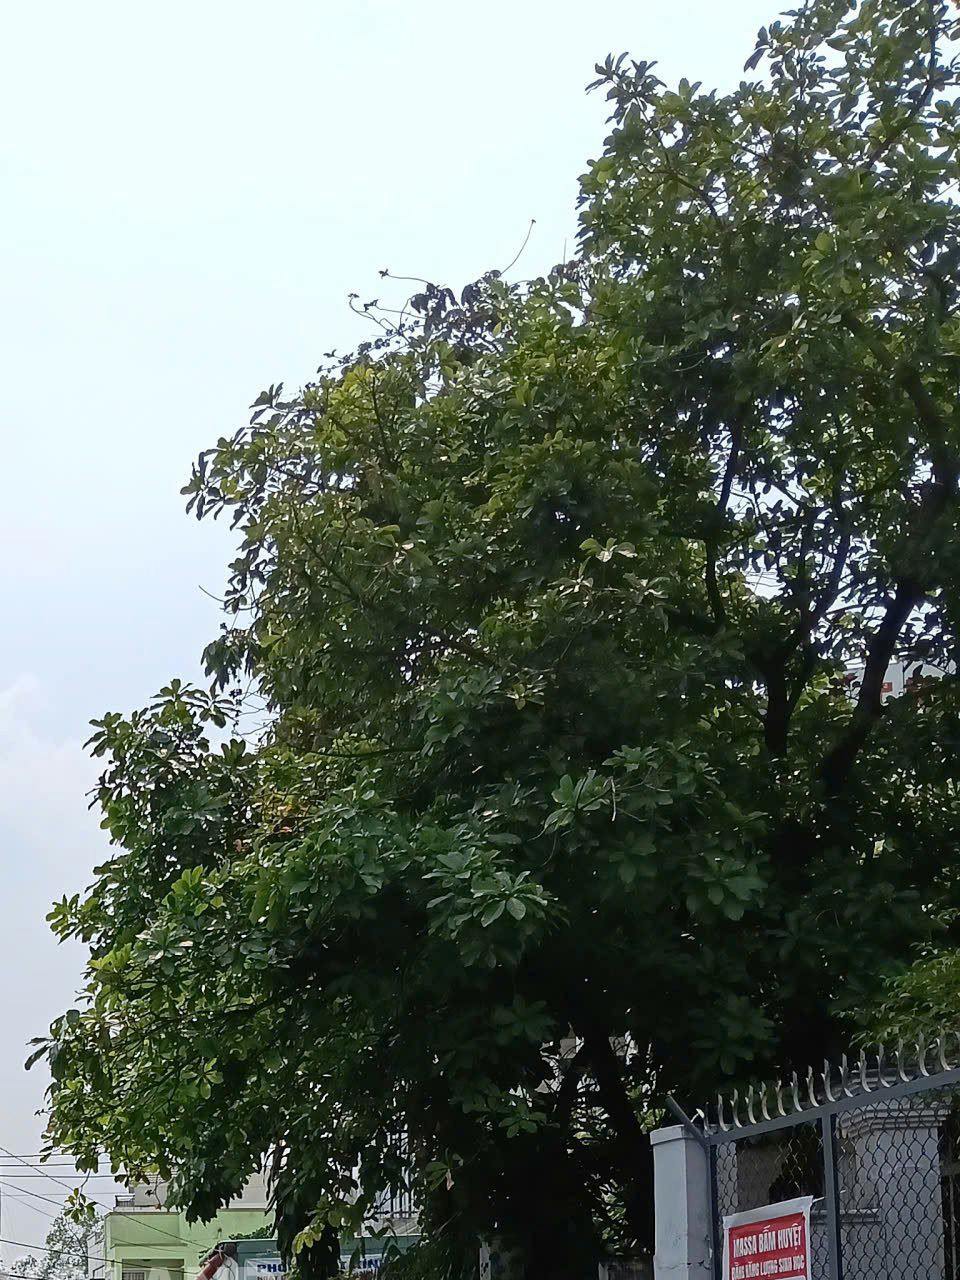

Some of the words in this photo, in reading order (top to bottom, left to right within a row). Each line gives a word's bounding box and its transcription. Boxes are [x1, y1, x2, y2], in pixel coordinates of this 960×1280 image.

[734, 1235, 757, 1258] MASSA
[759, 1225, 776, 1252] BẤM
[778, 1223, 801, 1250] HUYỆT
